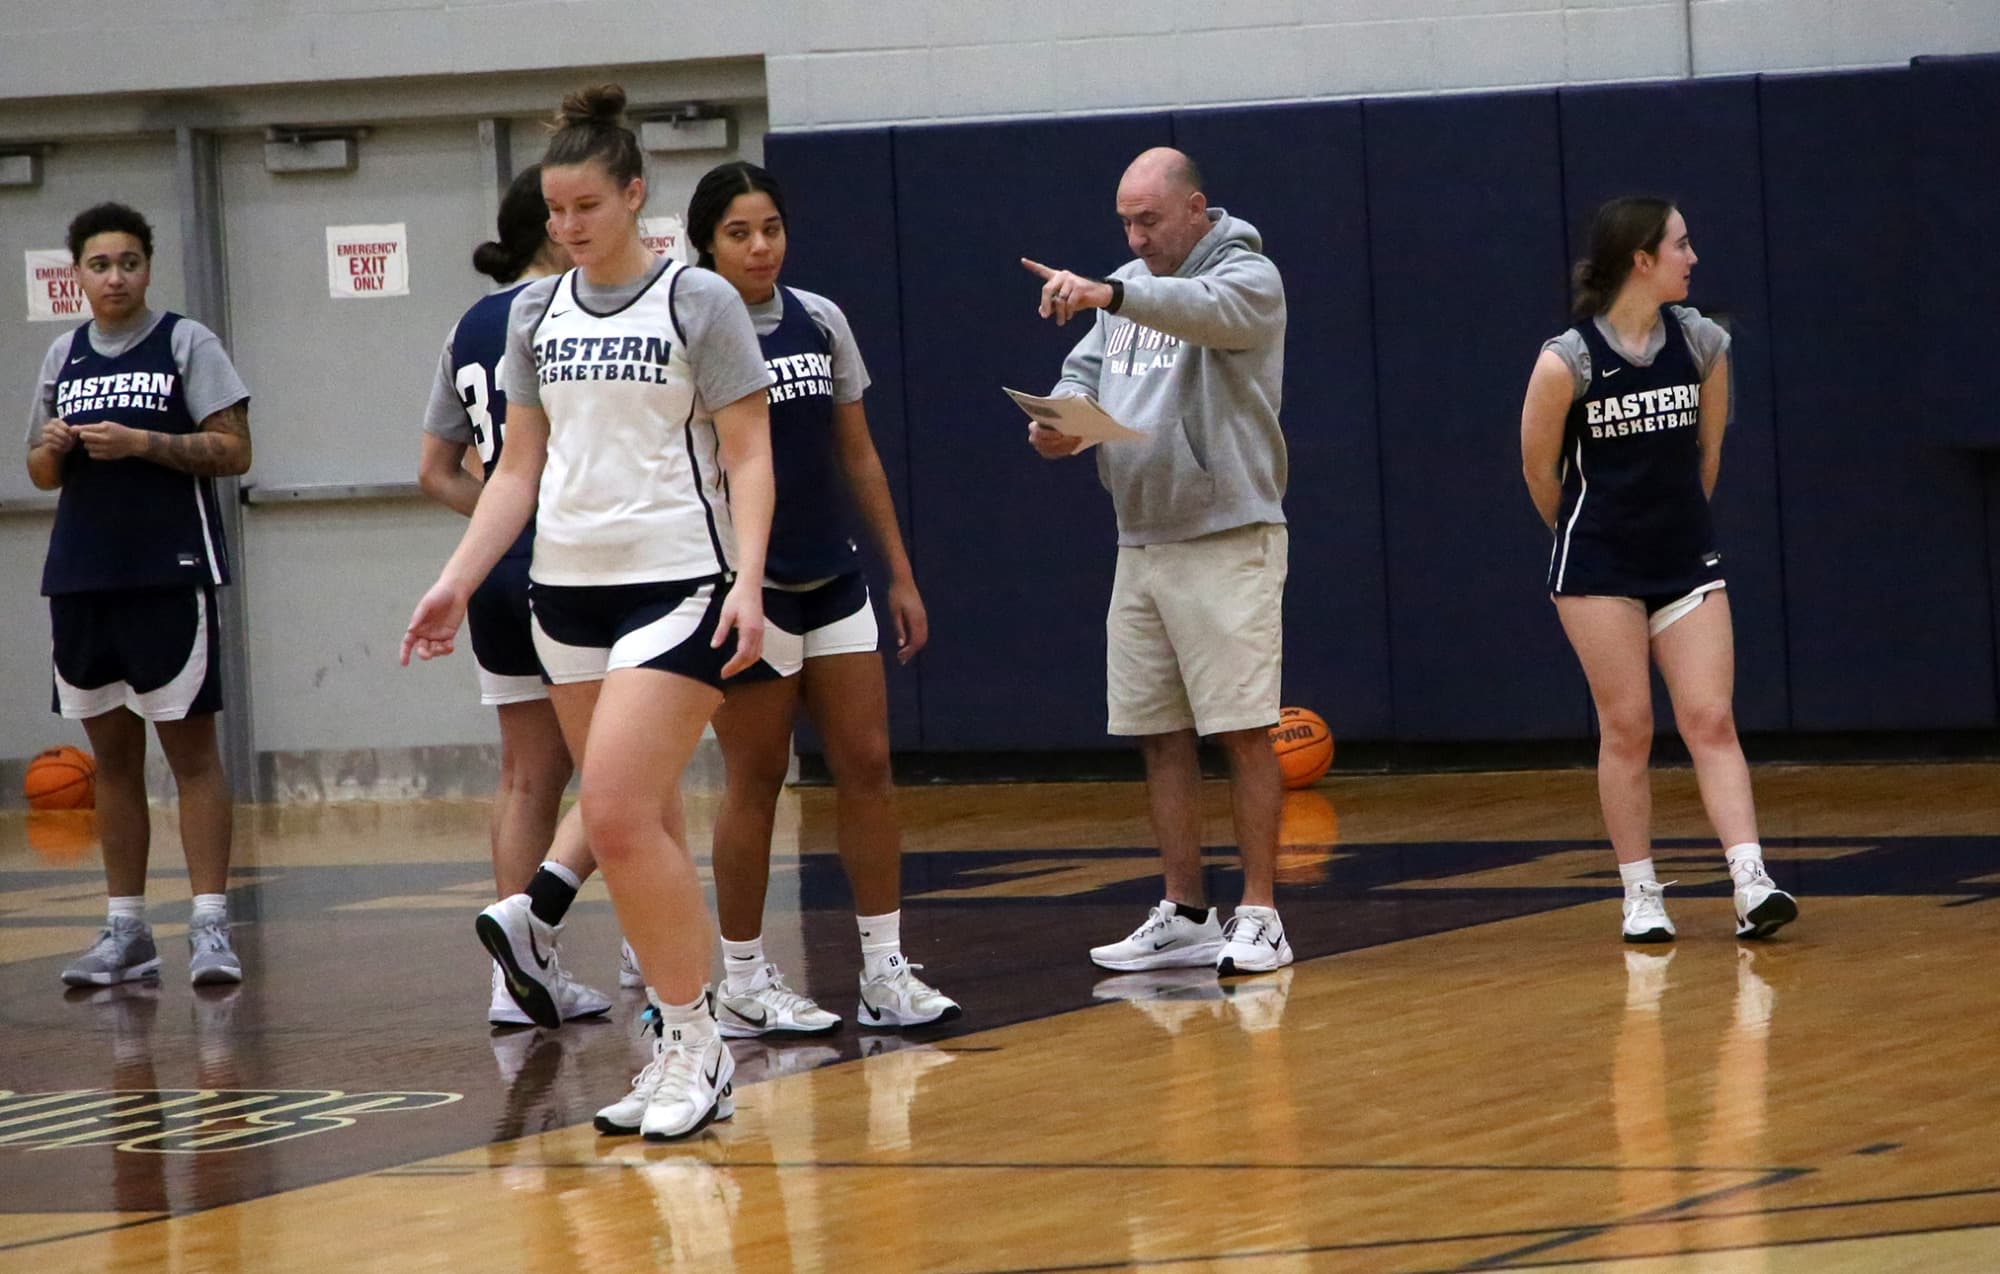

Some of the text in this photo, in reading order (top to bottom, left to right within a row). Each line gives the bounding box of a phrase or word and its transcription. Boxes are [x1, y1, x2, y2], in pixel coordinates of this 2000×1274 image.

[336, 241, 398, 257] EMERGENCY
[349, 255, 388, 276] EXIT
[353, 275, 385, 292] ONLY
[52, 299, 83, 314] ONLY
[538, 363, 668, 386] ASKETBALL
[764, 352, 832, 384] STERN
[56, 371, 176, 406] EASTERN
[1584, 383, 1701, 425] EASTERN
